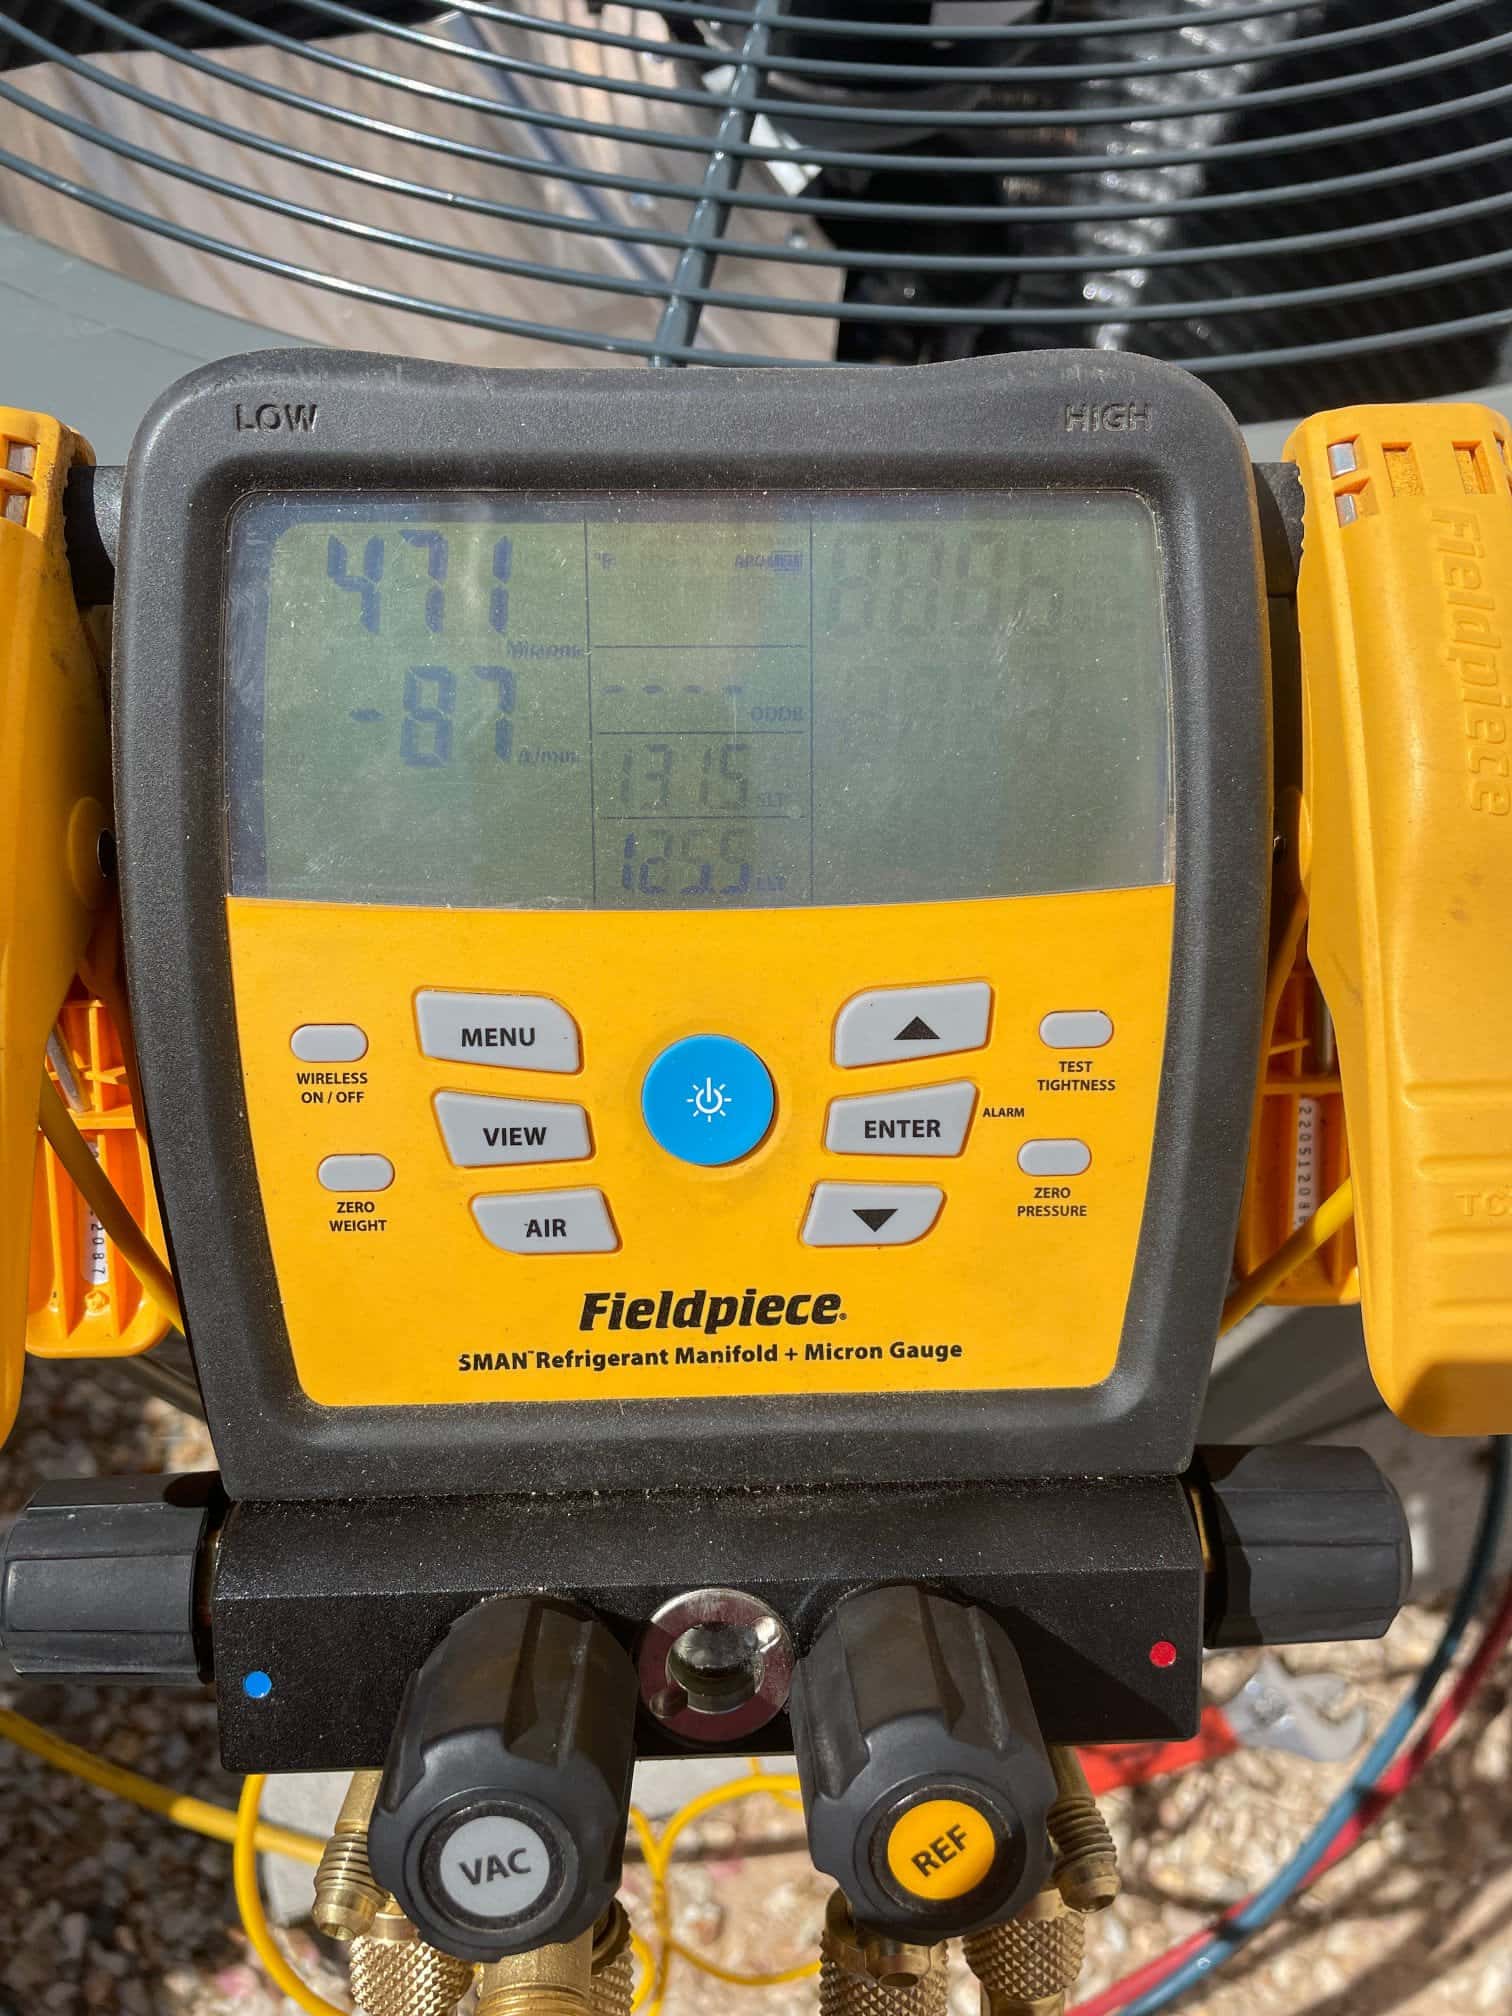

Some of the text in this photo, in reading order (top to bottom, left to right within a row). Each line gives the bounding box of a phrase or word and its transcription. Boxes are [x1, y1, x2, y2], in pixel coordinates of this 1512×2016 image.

[235, 403, 318, 433] LOW
[1064, 402, 1152, 432] HIGH
[326, 528, 514, 636] 471
[1430, 507, 1512, 818] Fieldpiece
[350, 664, 519, 769] -87
[461, 1027, 537, 1049] MENU
[1058, 1061, 1093, 1073] TEST
[296, 1072, 368, 1085] WIRELESS
[1037, 1079, 1116, 1092] TIGHTNESS
[301, 1091, 324, 1104] ON
[336, 1091, 365, 1104] OFF
[982, 1107, 1026, 1118] ALARM
[483, 1126, 548, 1147] VIEW
[863, 1119, 942, 1140] ENTER
[1034, 1187, 1071, 1200] ZERO
[336, 1201, 376, 1214] ZERO
[1017, 1205, 1088, 1218] PRESSURE
[329, 1219, 388, 1232] WEIGHT
[525, 1218, 568, 1239] AIR
[536, 1349, 669, 1371] Refrigerant
[675, 1343, 778, 1364] Manifold
[804, 1343, 883, 1361] Micron
[889, 1341, 963, 1362] Gauge
[911, 1823, 968, 1878] REF
[458, 1847, 532, 1886] VAC
